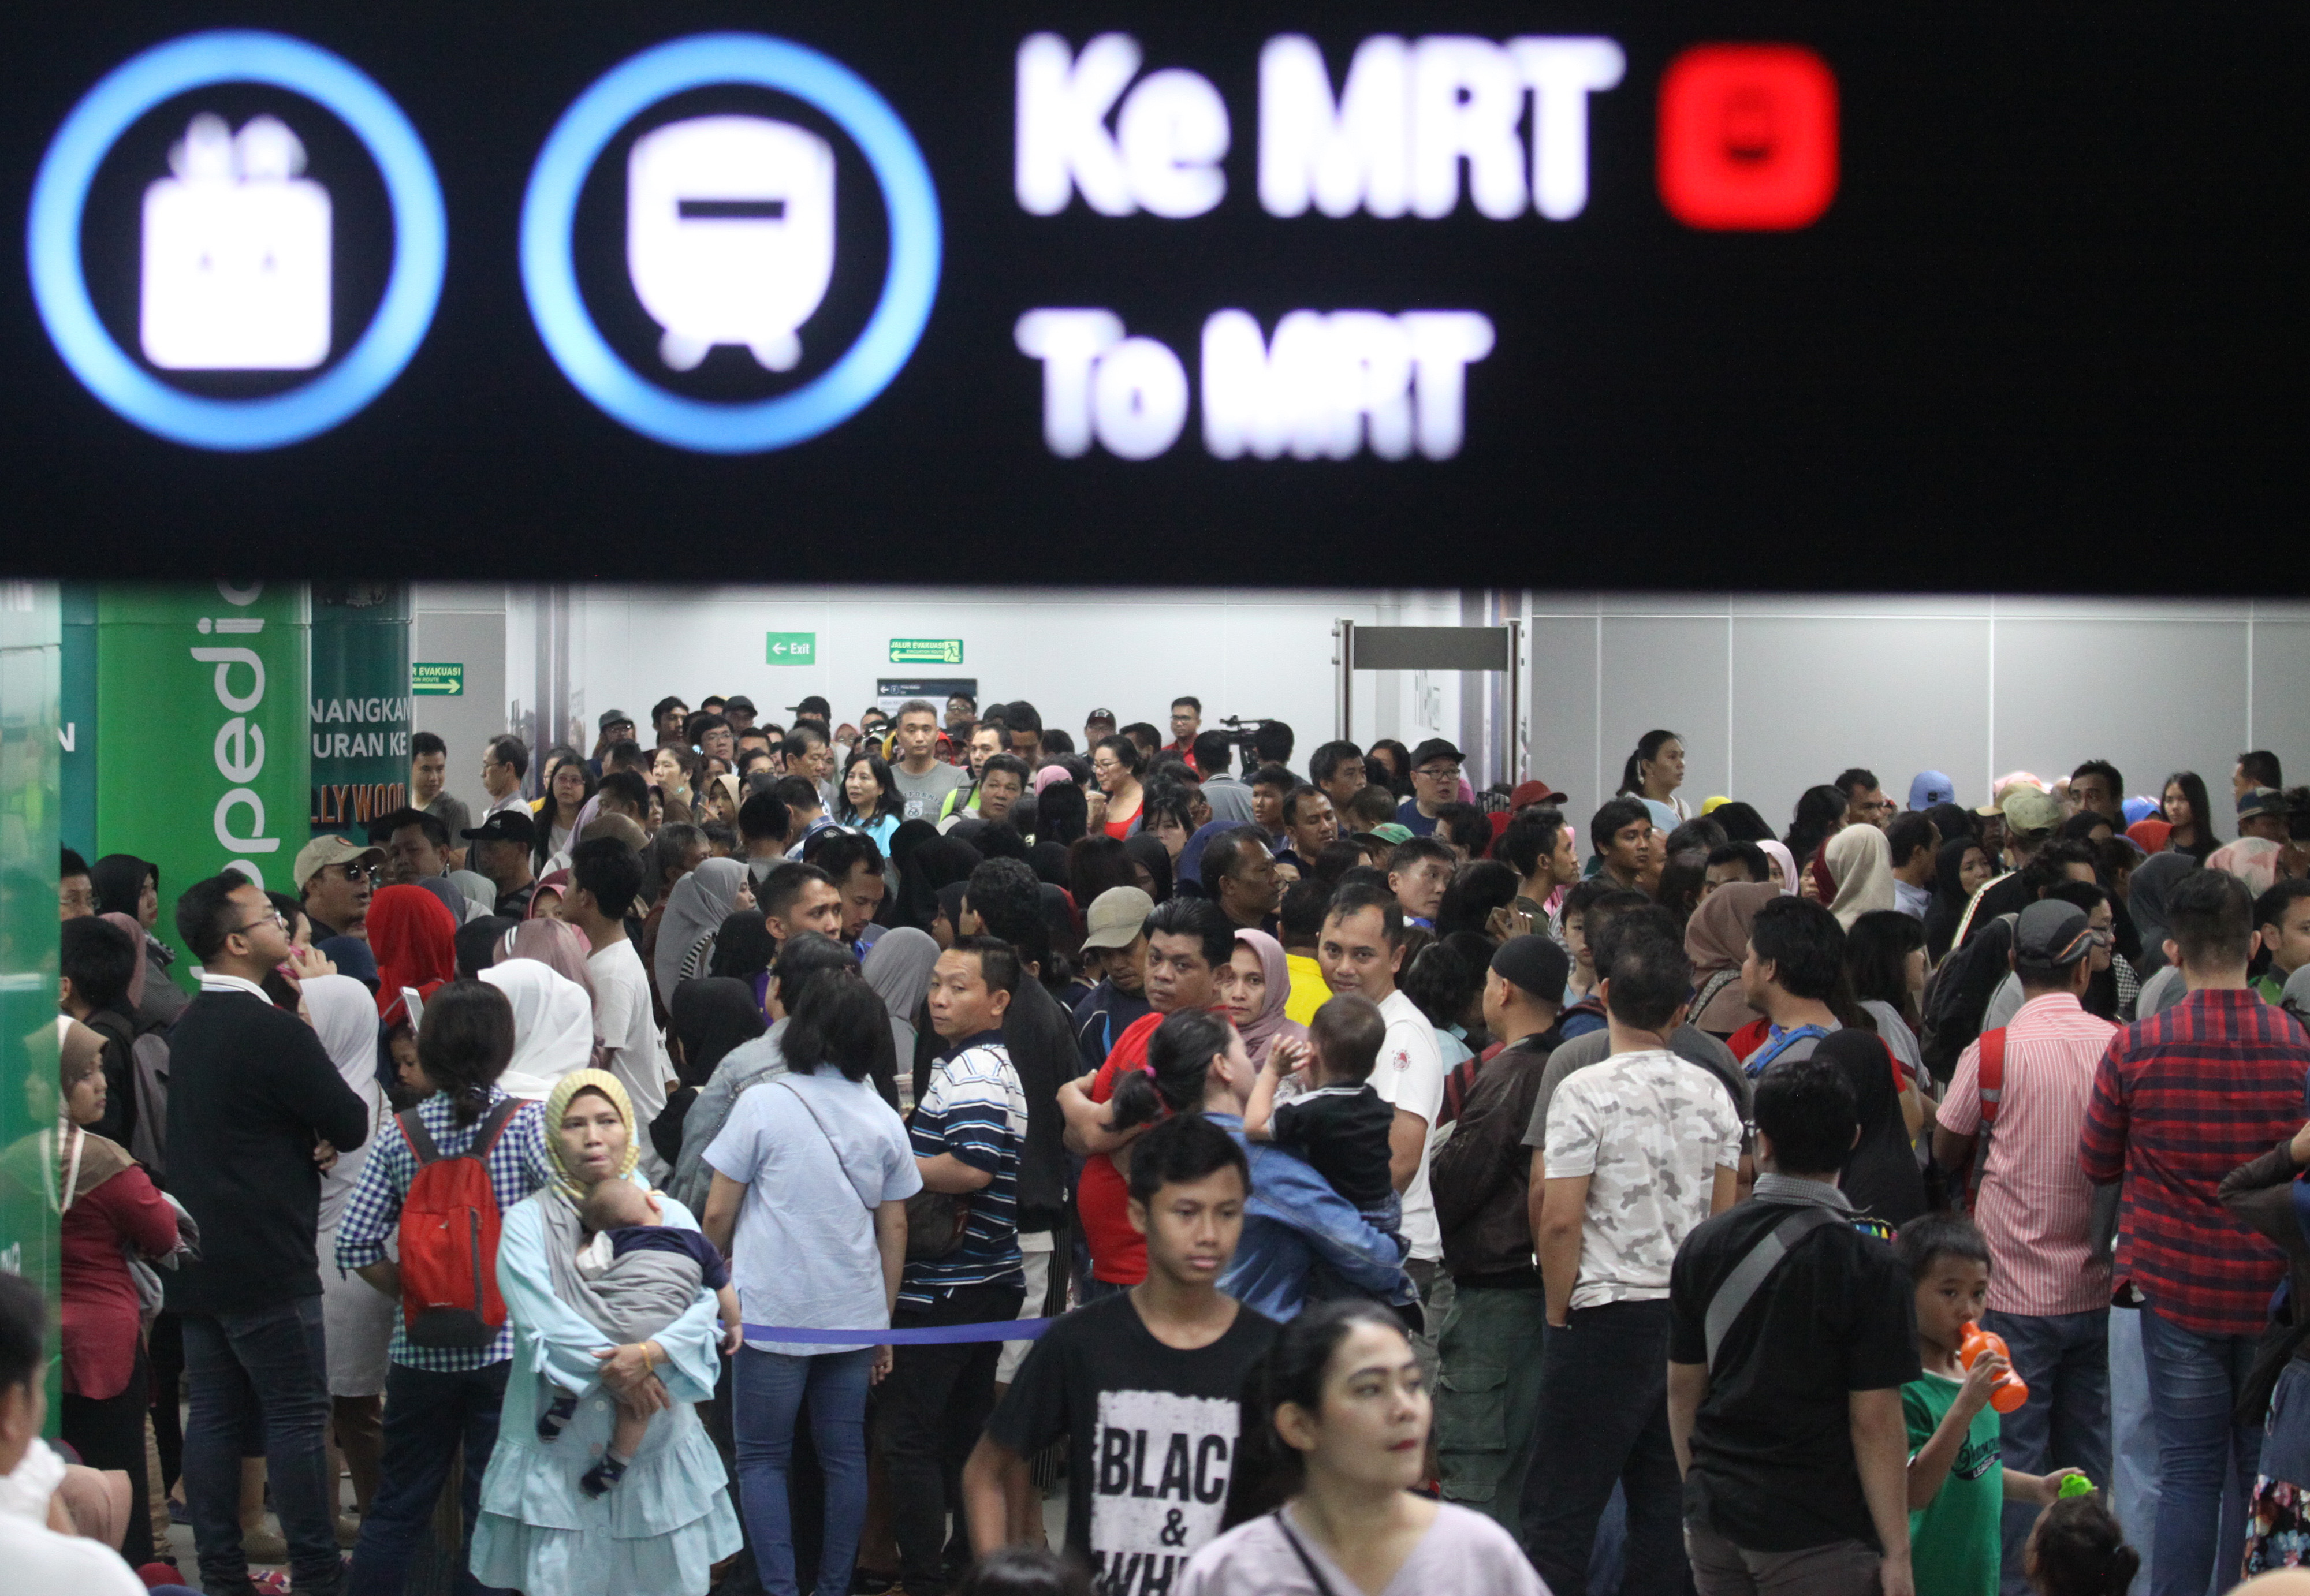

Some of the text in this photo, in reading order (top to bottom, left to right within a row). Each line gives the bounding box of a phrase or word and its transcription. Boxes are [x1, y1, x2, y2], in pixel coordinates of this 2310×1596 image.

[1014, 32, 1626, 221] Ke MRT
[1014, 308, 1495, 460] To MRT
[790, 643, 810, 654] Exit
[419, 666, 460, 676] EVAKUASI
[390, 732, 407, 756] KE
[908, 808, 919, 817] 66
[1160, 1508, 1188, 1546] &
